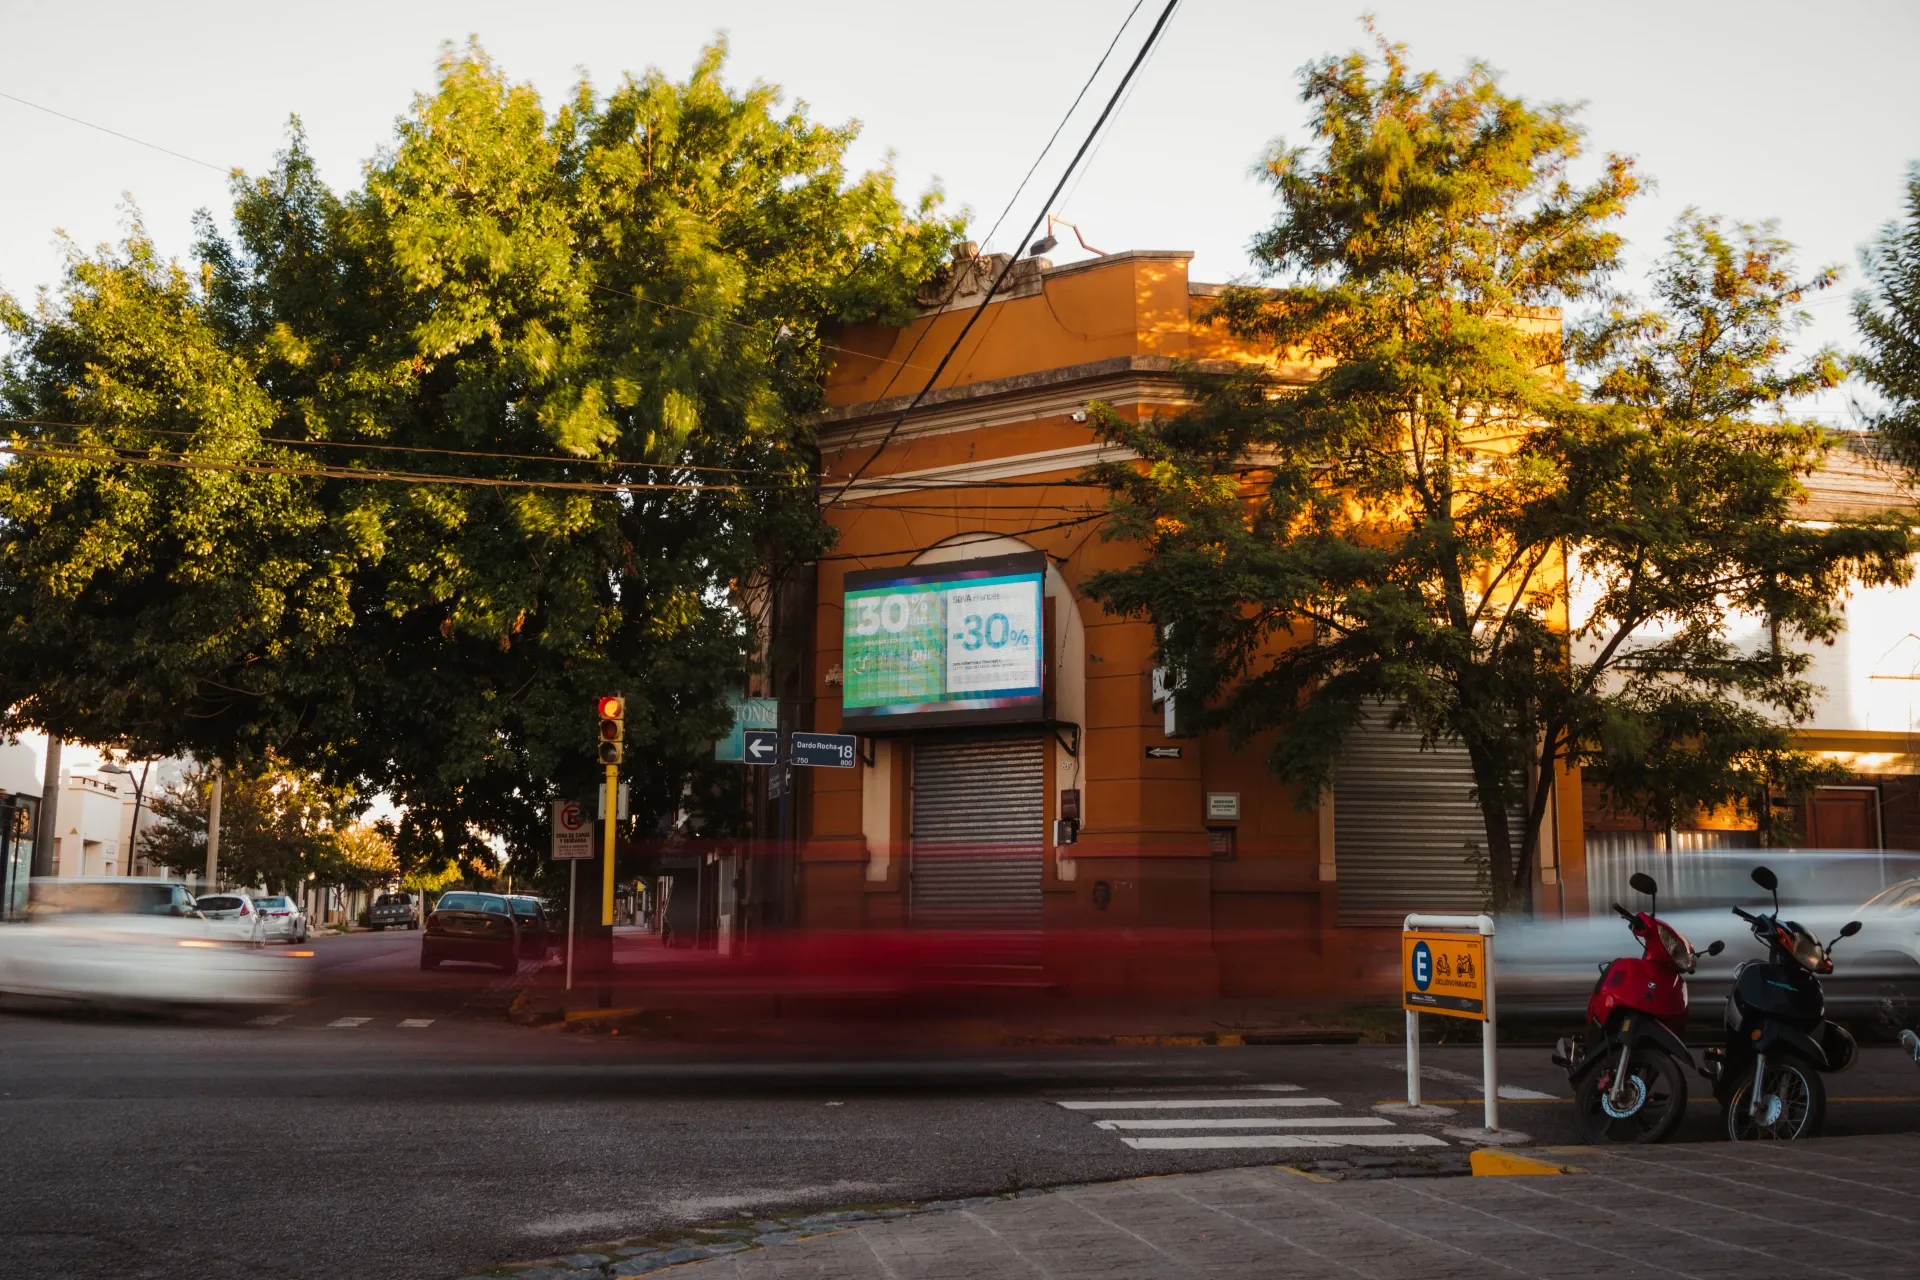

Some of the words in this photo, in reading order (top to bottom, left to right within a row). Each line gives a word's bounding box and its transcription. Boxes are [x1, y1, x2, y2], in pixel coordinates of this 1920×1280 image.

[733, 705, 776, 722] TONIO
[797, 741, 816, 749] Dardo
[817, 742, 838, 751] Rocha
[837, 745, 853, 759] 18
[1416, 951, 1428, 982] E
[1435, 978, 1455, 987] EXCLUSIVO
[1455, 980, 1464, 988] PARA
[1464, 981, 1478, 989] MOTOS
